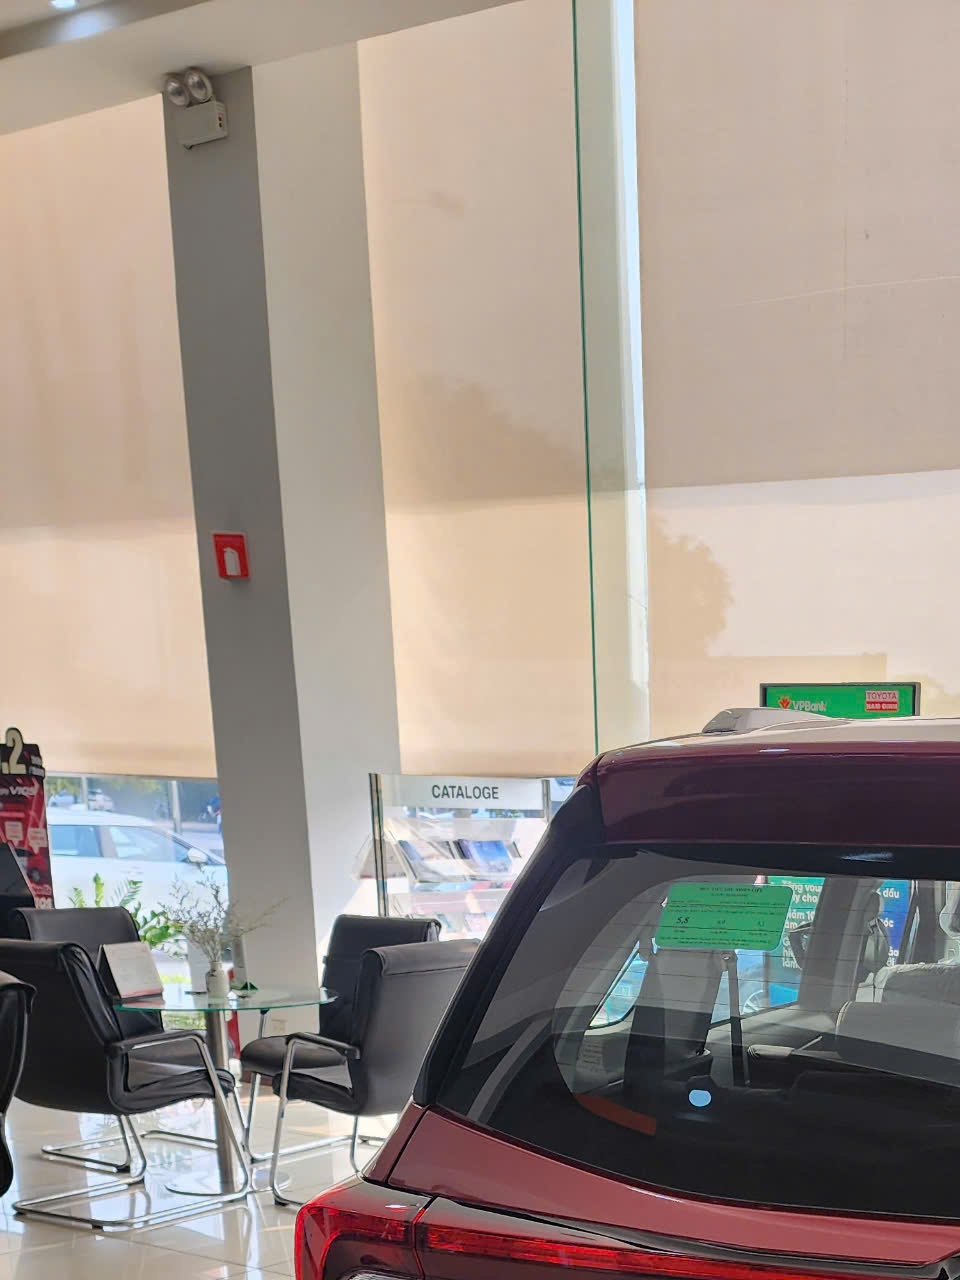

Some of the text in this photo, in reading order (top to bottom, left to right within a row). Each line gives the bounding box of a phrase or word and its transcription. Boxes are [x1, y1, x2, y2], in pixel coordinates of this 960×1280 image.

[866, 691, 897, 700] TOYOTA
[792, 700, 827, 712] VPBank
[431, 785, 500, 800] CATALOGE
